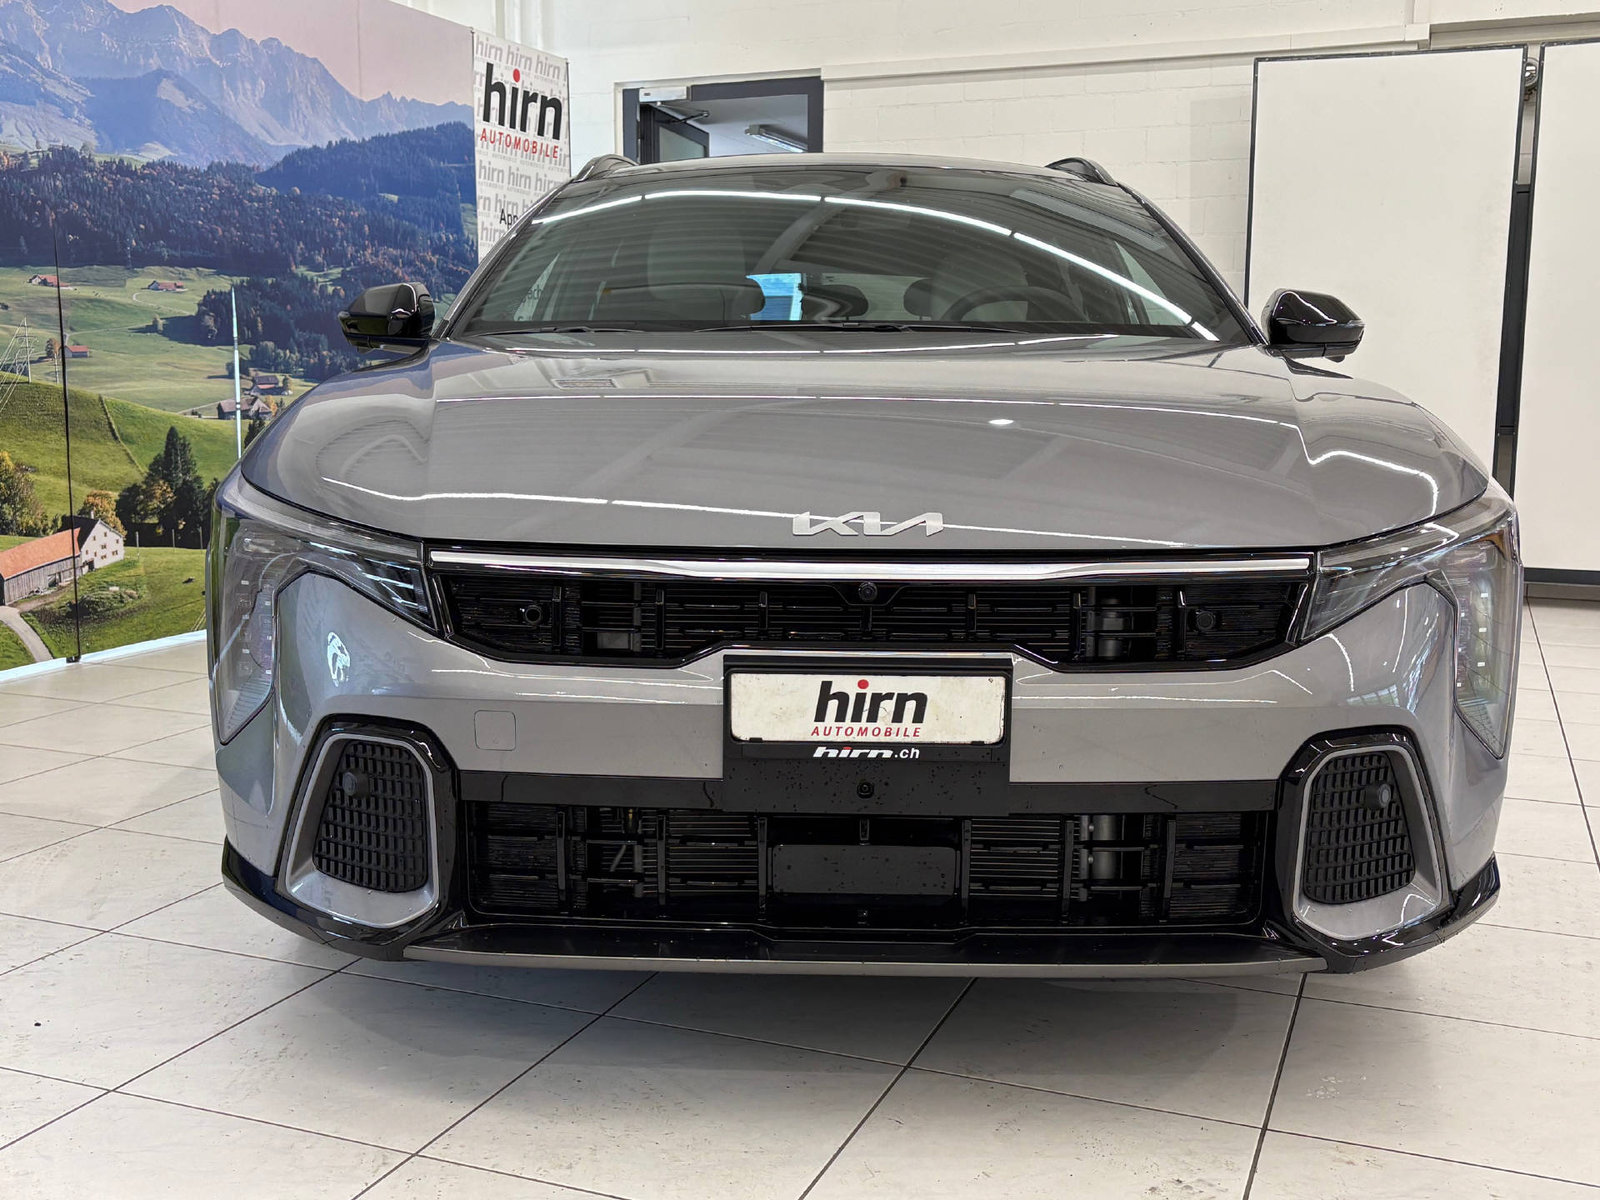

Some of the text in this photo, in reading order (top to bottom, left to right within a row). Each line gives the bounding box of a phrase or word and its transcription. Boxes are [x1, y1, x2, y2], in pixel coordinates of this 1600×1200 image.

[475, 35, 560, 80] hirn hirn hirn
[482, 62, 562, 140] hirn
[480, 128, 559, 159] AUTOMOBILE
[478, 160, 504, 184] hirn
[507, 166, 531, 190] hirn
[813, 679, 928, 724] hirn
[811, 726, 922, 738] AUTOMOBILE
[812, 746, 920, 759] hirn.ch
